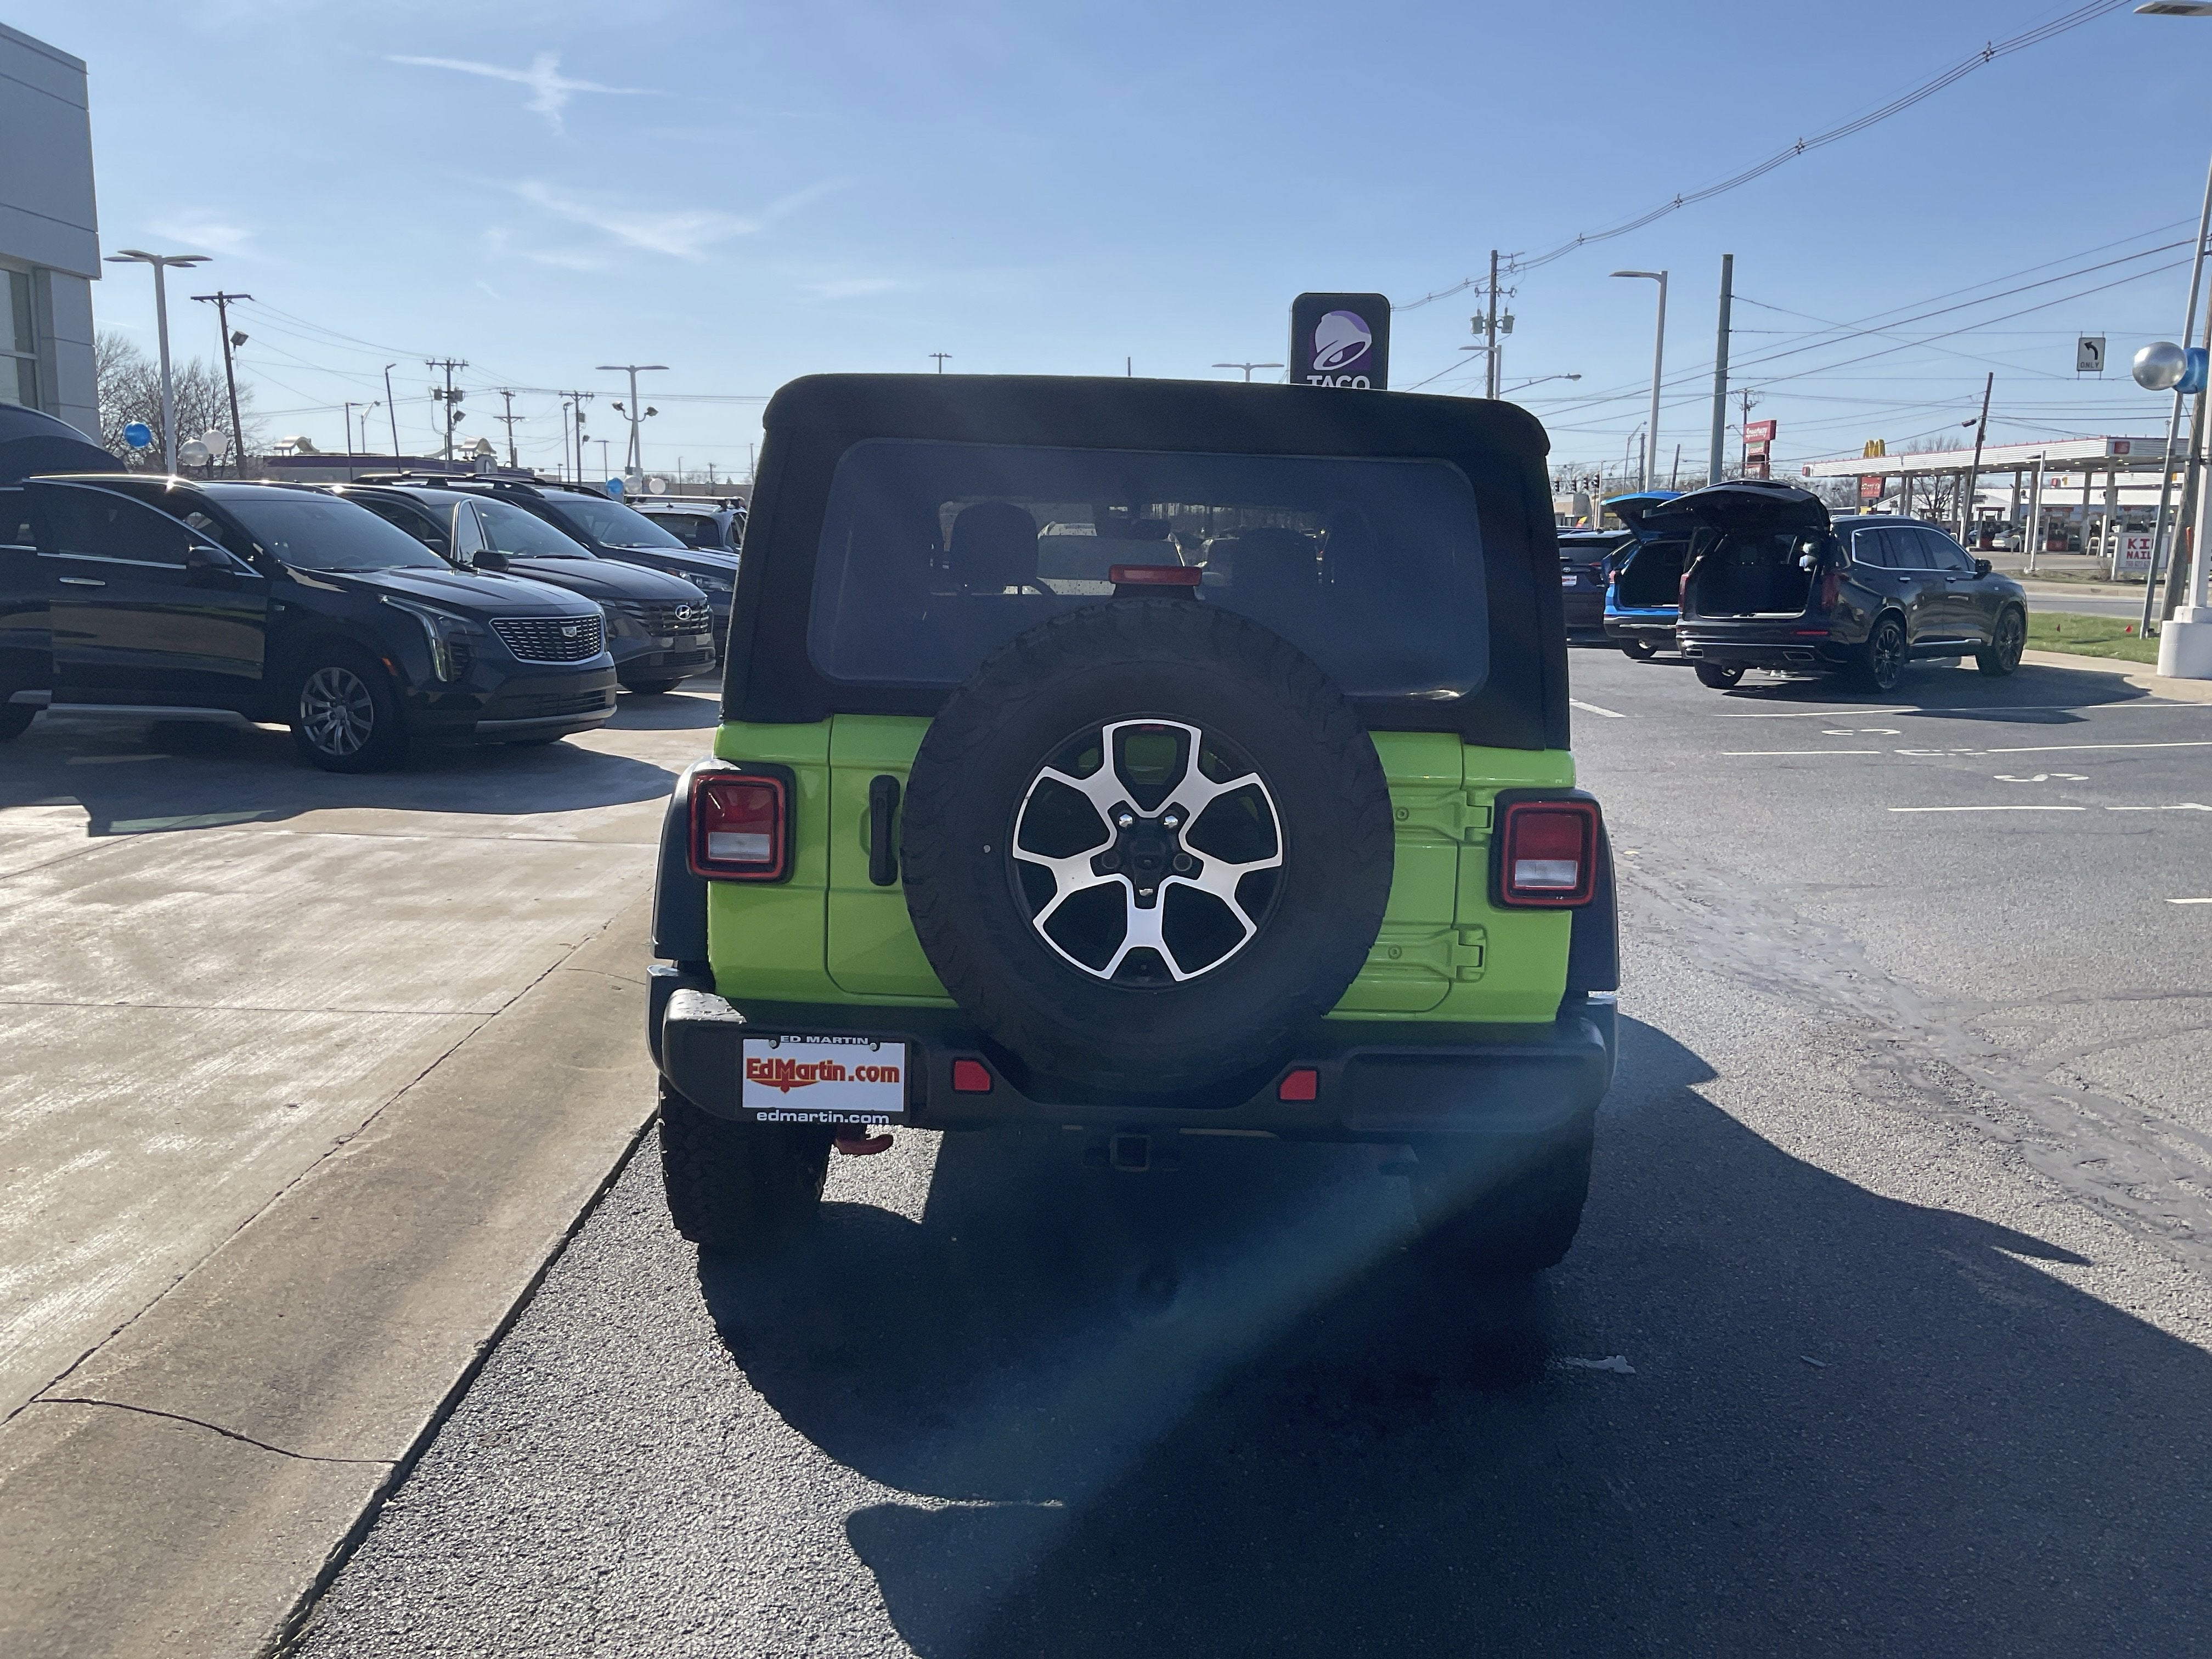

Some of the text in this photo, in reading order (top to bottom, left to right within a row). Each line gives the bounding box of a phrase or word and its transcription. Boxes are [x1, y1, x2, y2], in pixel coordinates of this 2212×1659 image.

[1306, 375, 1370, 390] TACO
[2128, 538, 2154, 549] KI
[806, 1036, 868, 1045] MARTIN
[746, 1057, 900, 1084] EdMartin.com
[757, 1109, 890, 1125] edmartin.com
